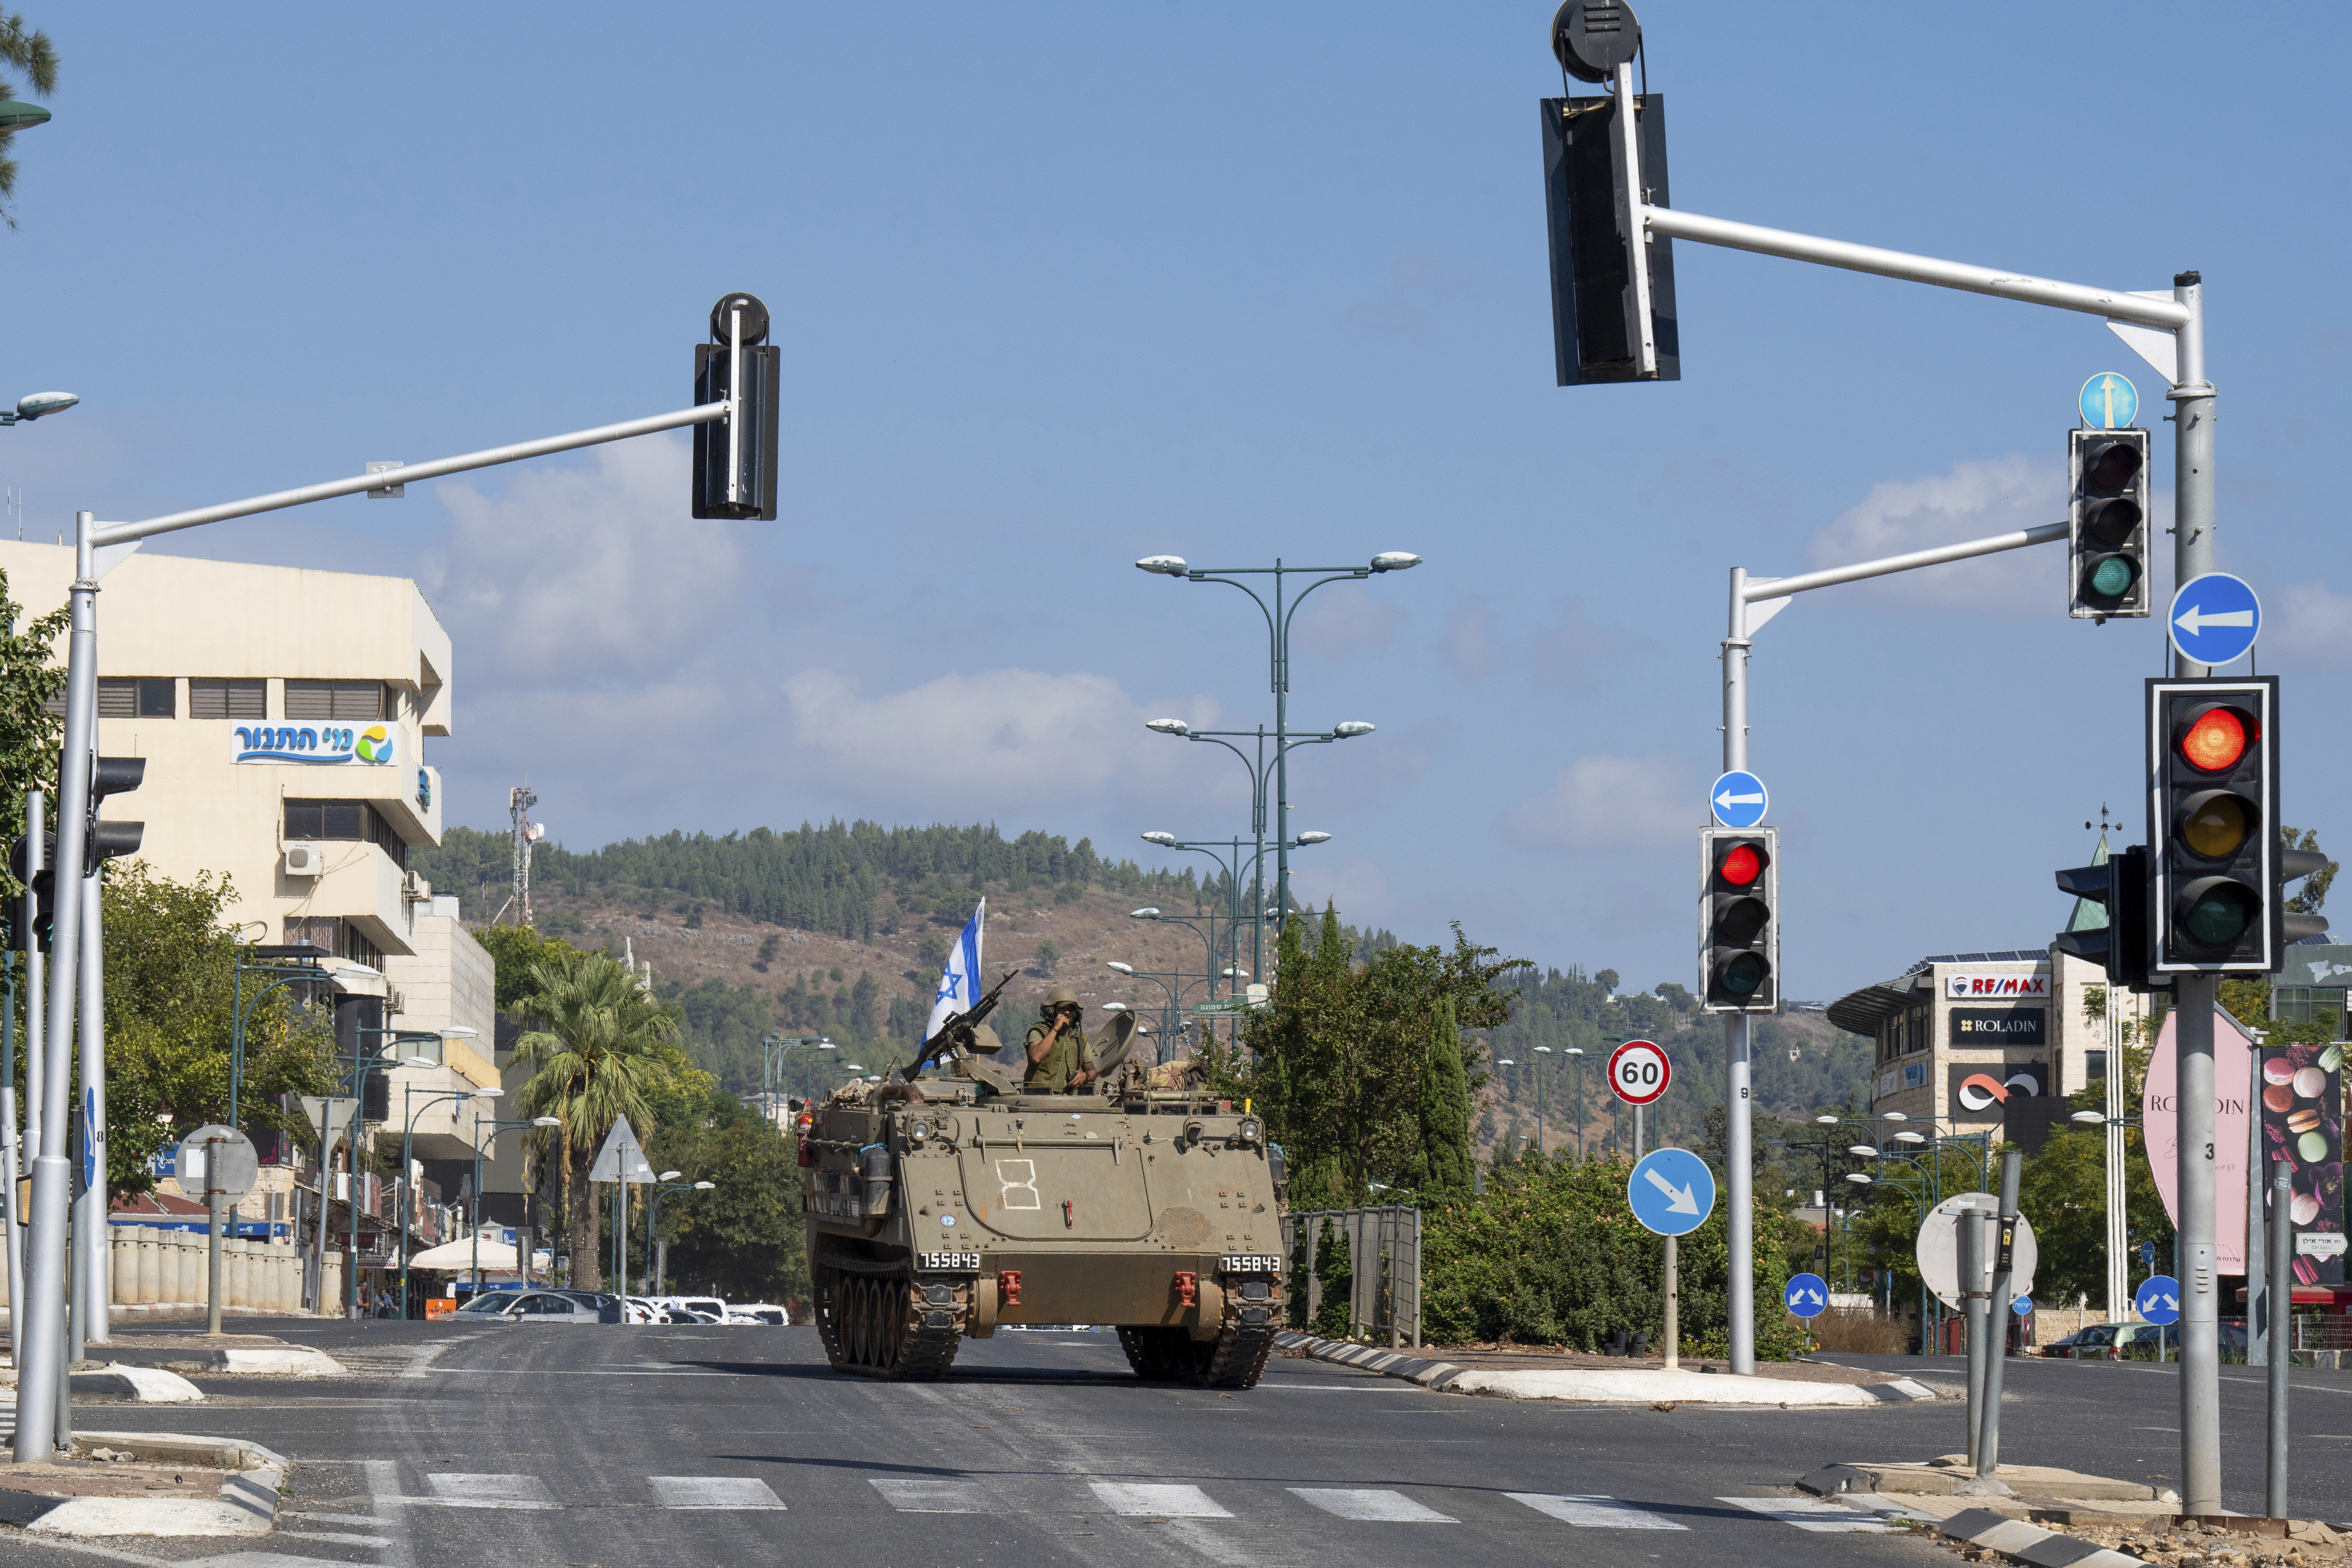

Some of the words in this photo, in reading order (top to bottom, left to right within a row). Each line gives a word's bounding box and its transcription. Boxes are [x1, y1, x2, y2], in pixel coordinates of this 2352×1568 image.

[236, 726, 318, 747] התנור
[323, 727, 353, 748] מי
[1973, 978, 2044, 993] RE/MAX
[1975, 1021, 2036, 1032] ROLADIN
[1622, 1062, 1658, 1085] 60
[1741, 1087, 1748, 1099] 9
[2151, 1095, 2244, 1114] RODIN
[97, 1131, 103, 1142] 8
[2205, 1143, 2214, 1160] 3
[921, 1253, 980, 1268] 755843
[1222, 1257, 1280, 1272] 755843
